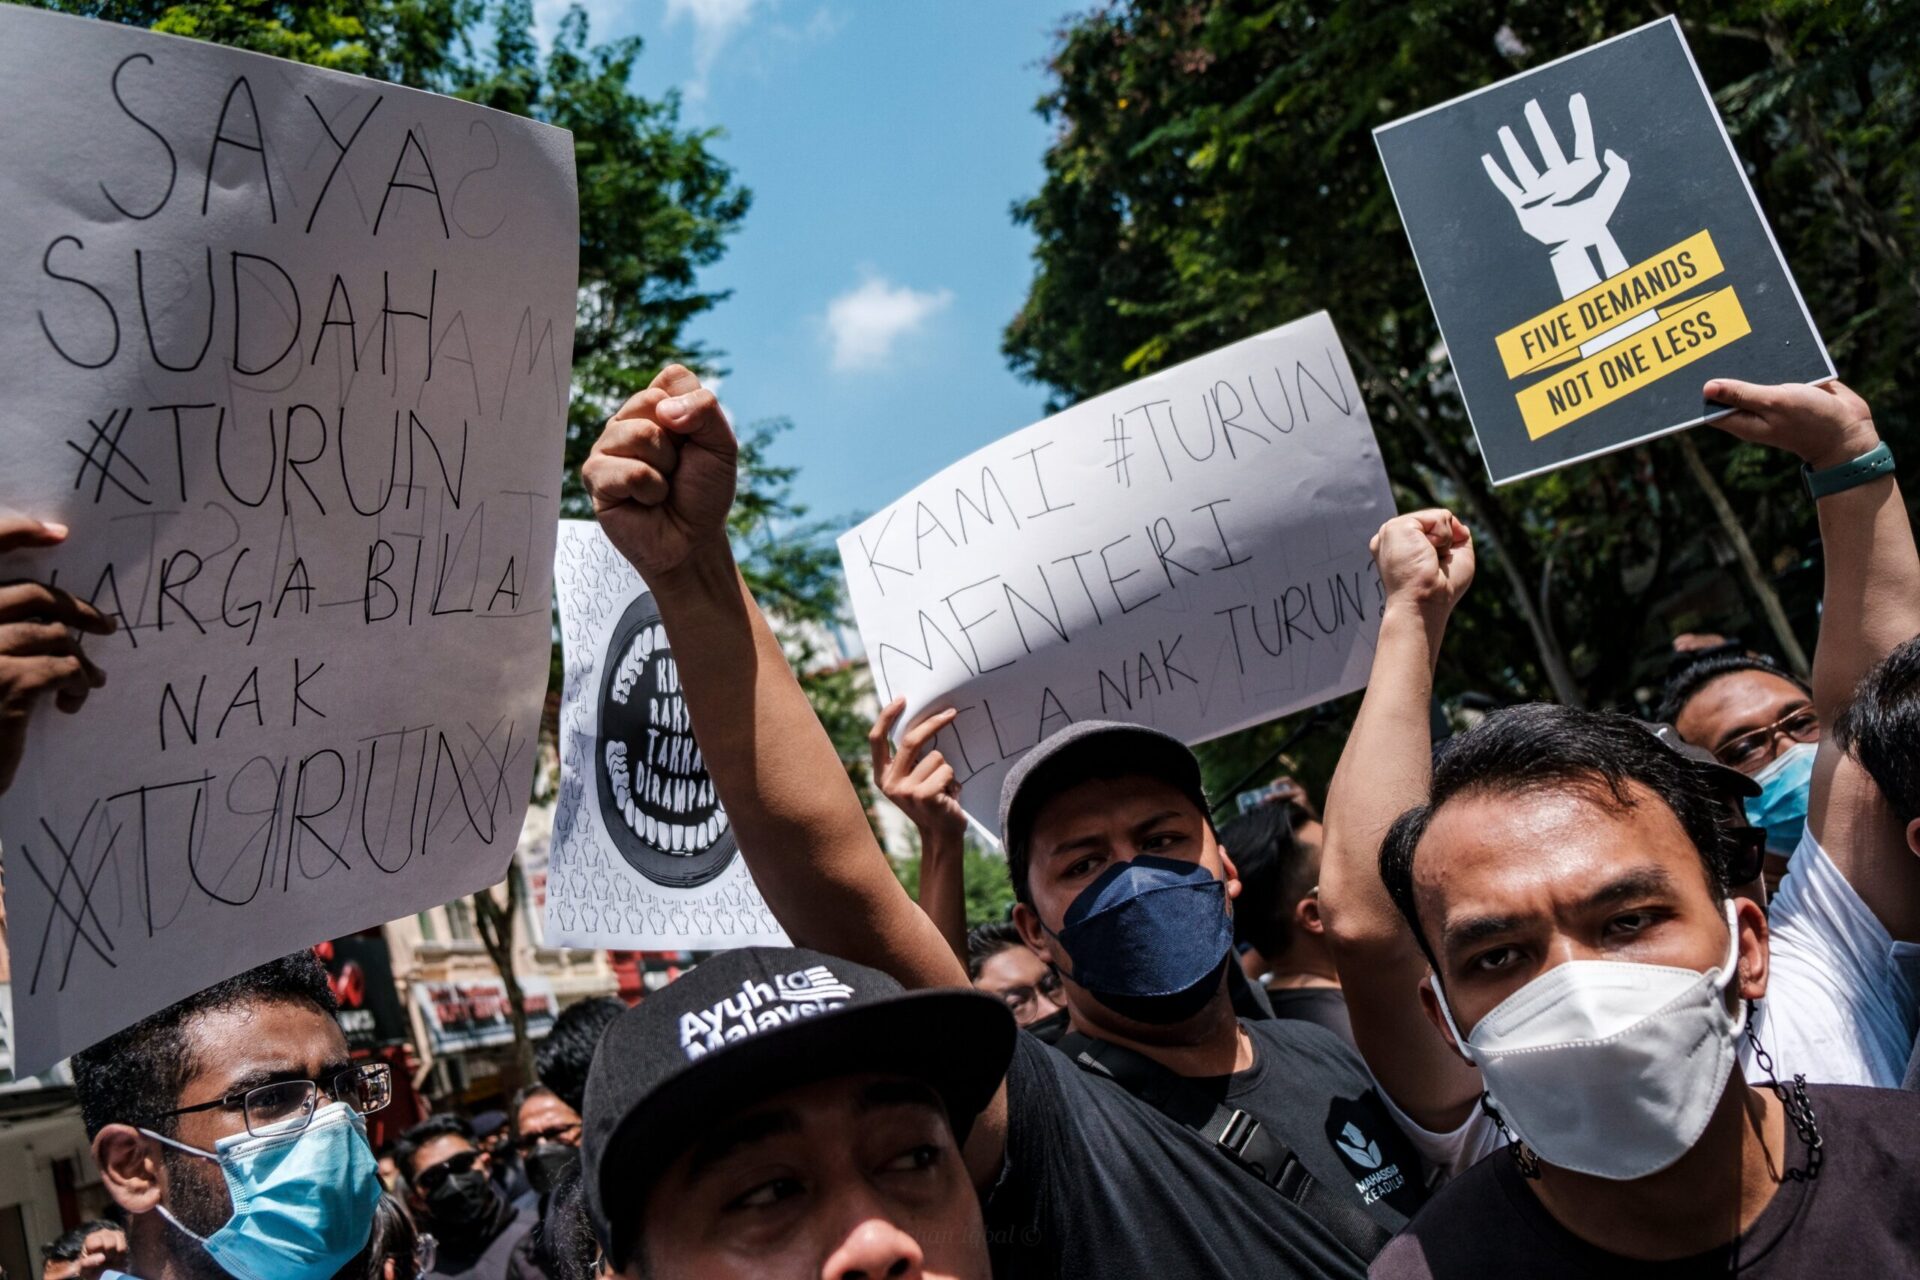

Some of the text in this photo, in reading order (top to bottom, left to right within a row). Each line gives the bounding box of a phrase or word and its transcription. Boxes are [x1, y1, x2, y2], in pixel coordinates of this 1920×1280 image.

[99, 53, 450, 239] SAYA
[36, 235, 438, 383] SUDAH
[1520, 250, 1698, 360] FIVE DEMANDS
[1546, 310, 1718, 417] NOT ONE LESS
[66, 403, 468, 517] #TURUN
[859, 441, 1076, 597] KAMI
[1103, 347, 1352, 488] #TURUN
[363, 532, 520, 626] BILA
[879, 499, 1253, 702] MENTERI
[158, 657, 326, 751] NAK
[914, 686, 1074, 785] ILA
[1098, 634, 1199, 714] NAK
[20, 730, 516, 997] #TURUN
[679, 979, 779, 1048] Ayuh
[1363, 1174, 1405, 1206] KEADILA
